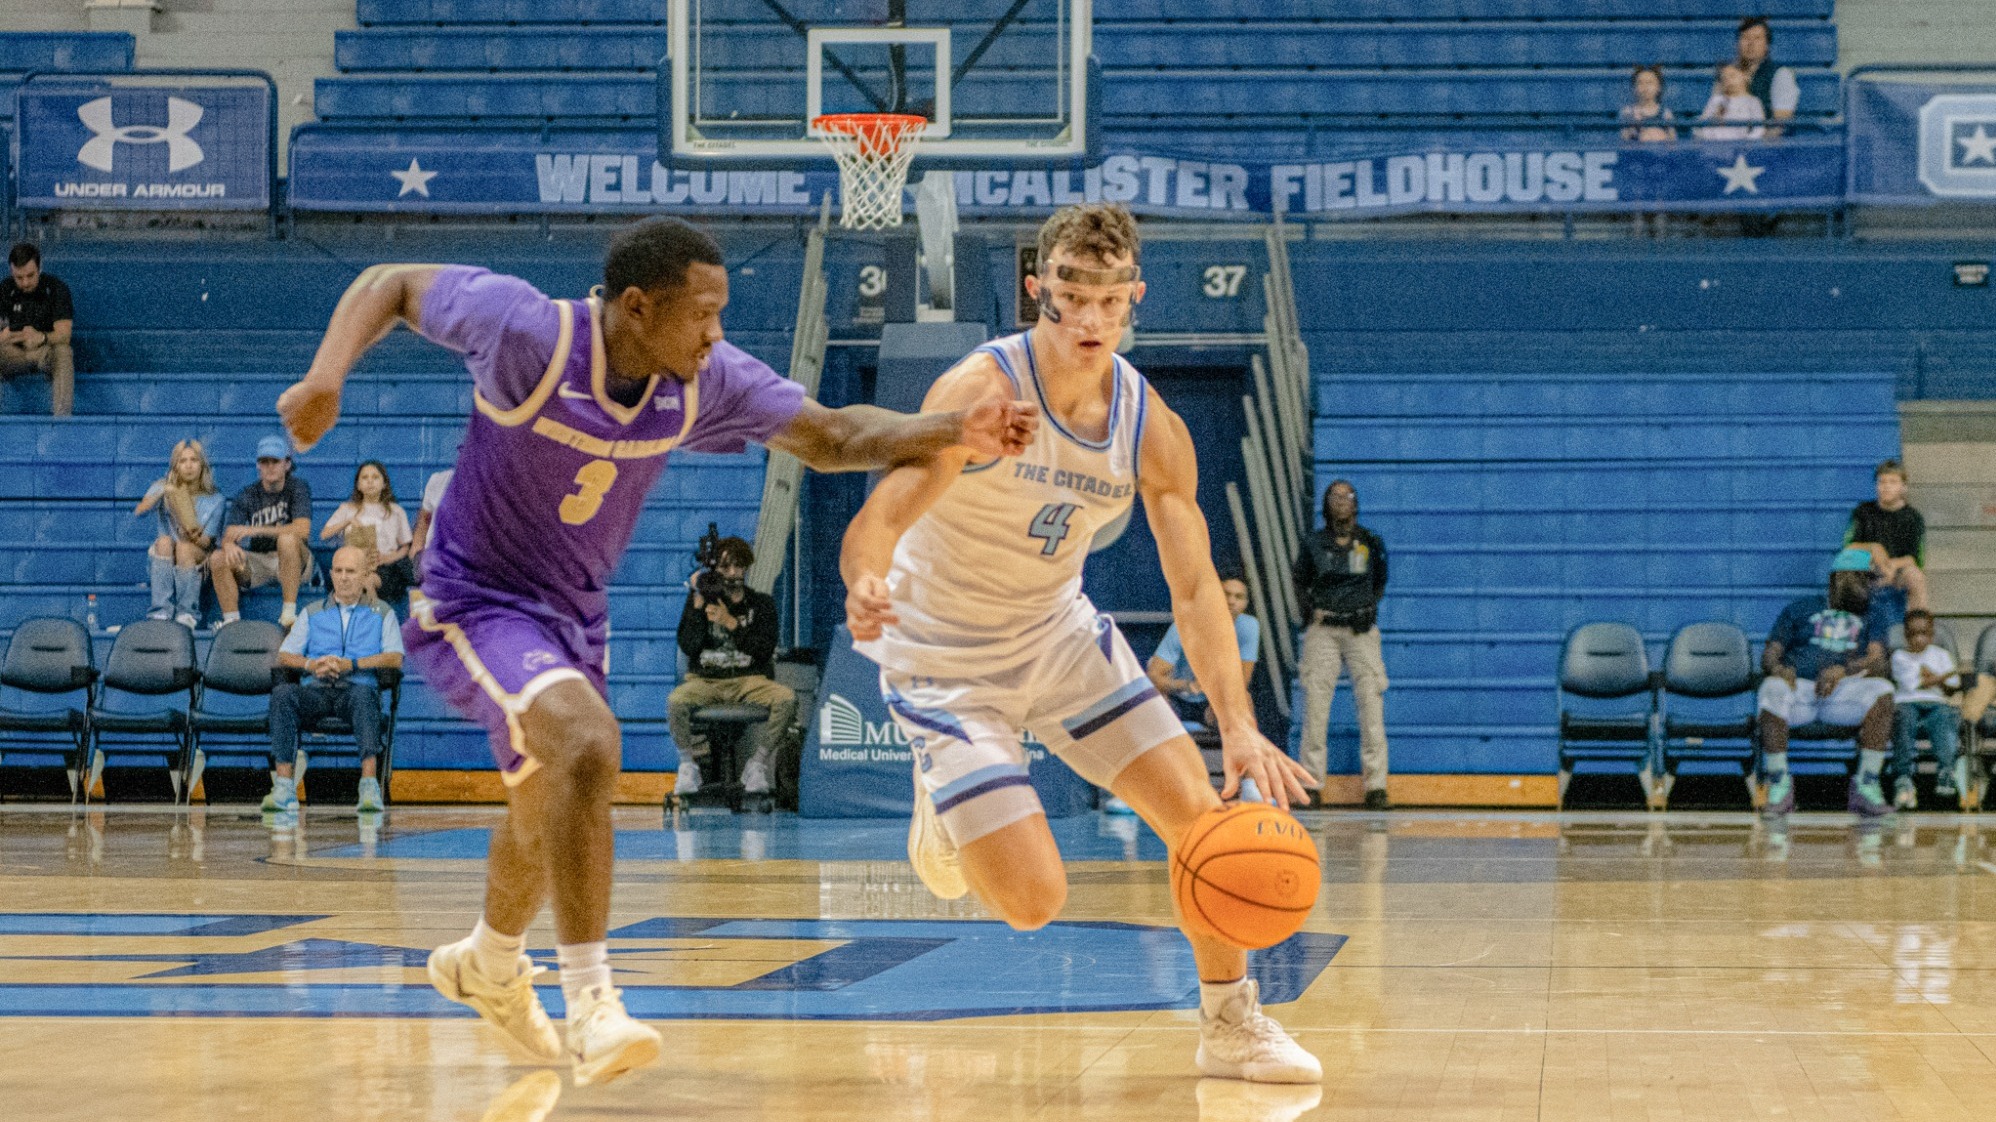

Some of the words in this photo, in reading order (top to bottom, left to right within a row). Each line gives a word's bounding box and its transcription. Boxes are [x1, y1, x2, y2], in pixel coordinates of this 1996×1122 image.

[54, 183, 127, 197] UNDER
[133, 183, 225, 197] ARMOUR
[535, 154, 810, 205] WELCOME
[1271, 152, 1619, 211] FIELDHOUSE
[1203, 265, 1247, 297] 37
[1014, 461, 1050, 484] THE
[558, 459, 618, 525] 3
[1028, 502, 1080, 556] 4
[864, 721, 910, 745] MU
[820, 748, 868, 761] Medical
[871, 748, 913, 761] Univer
